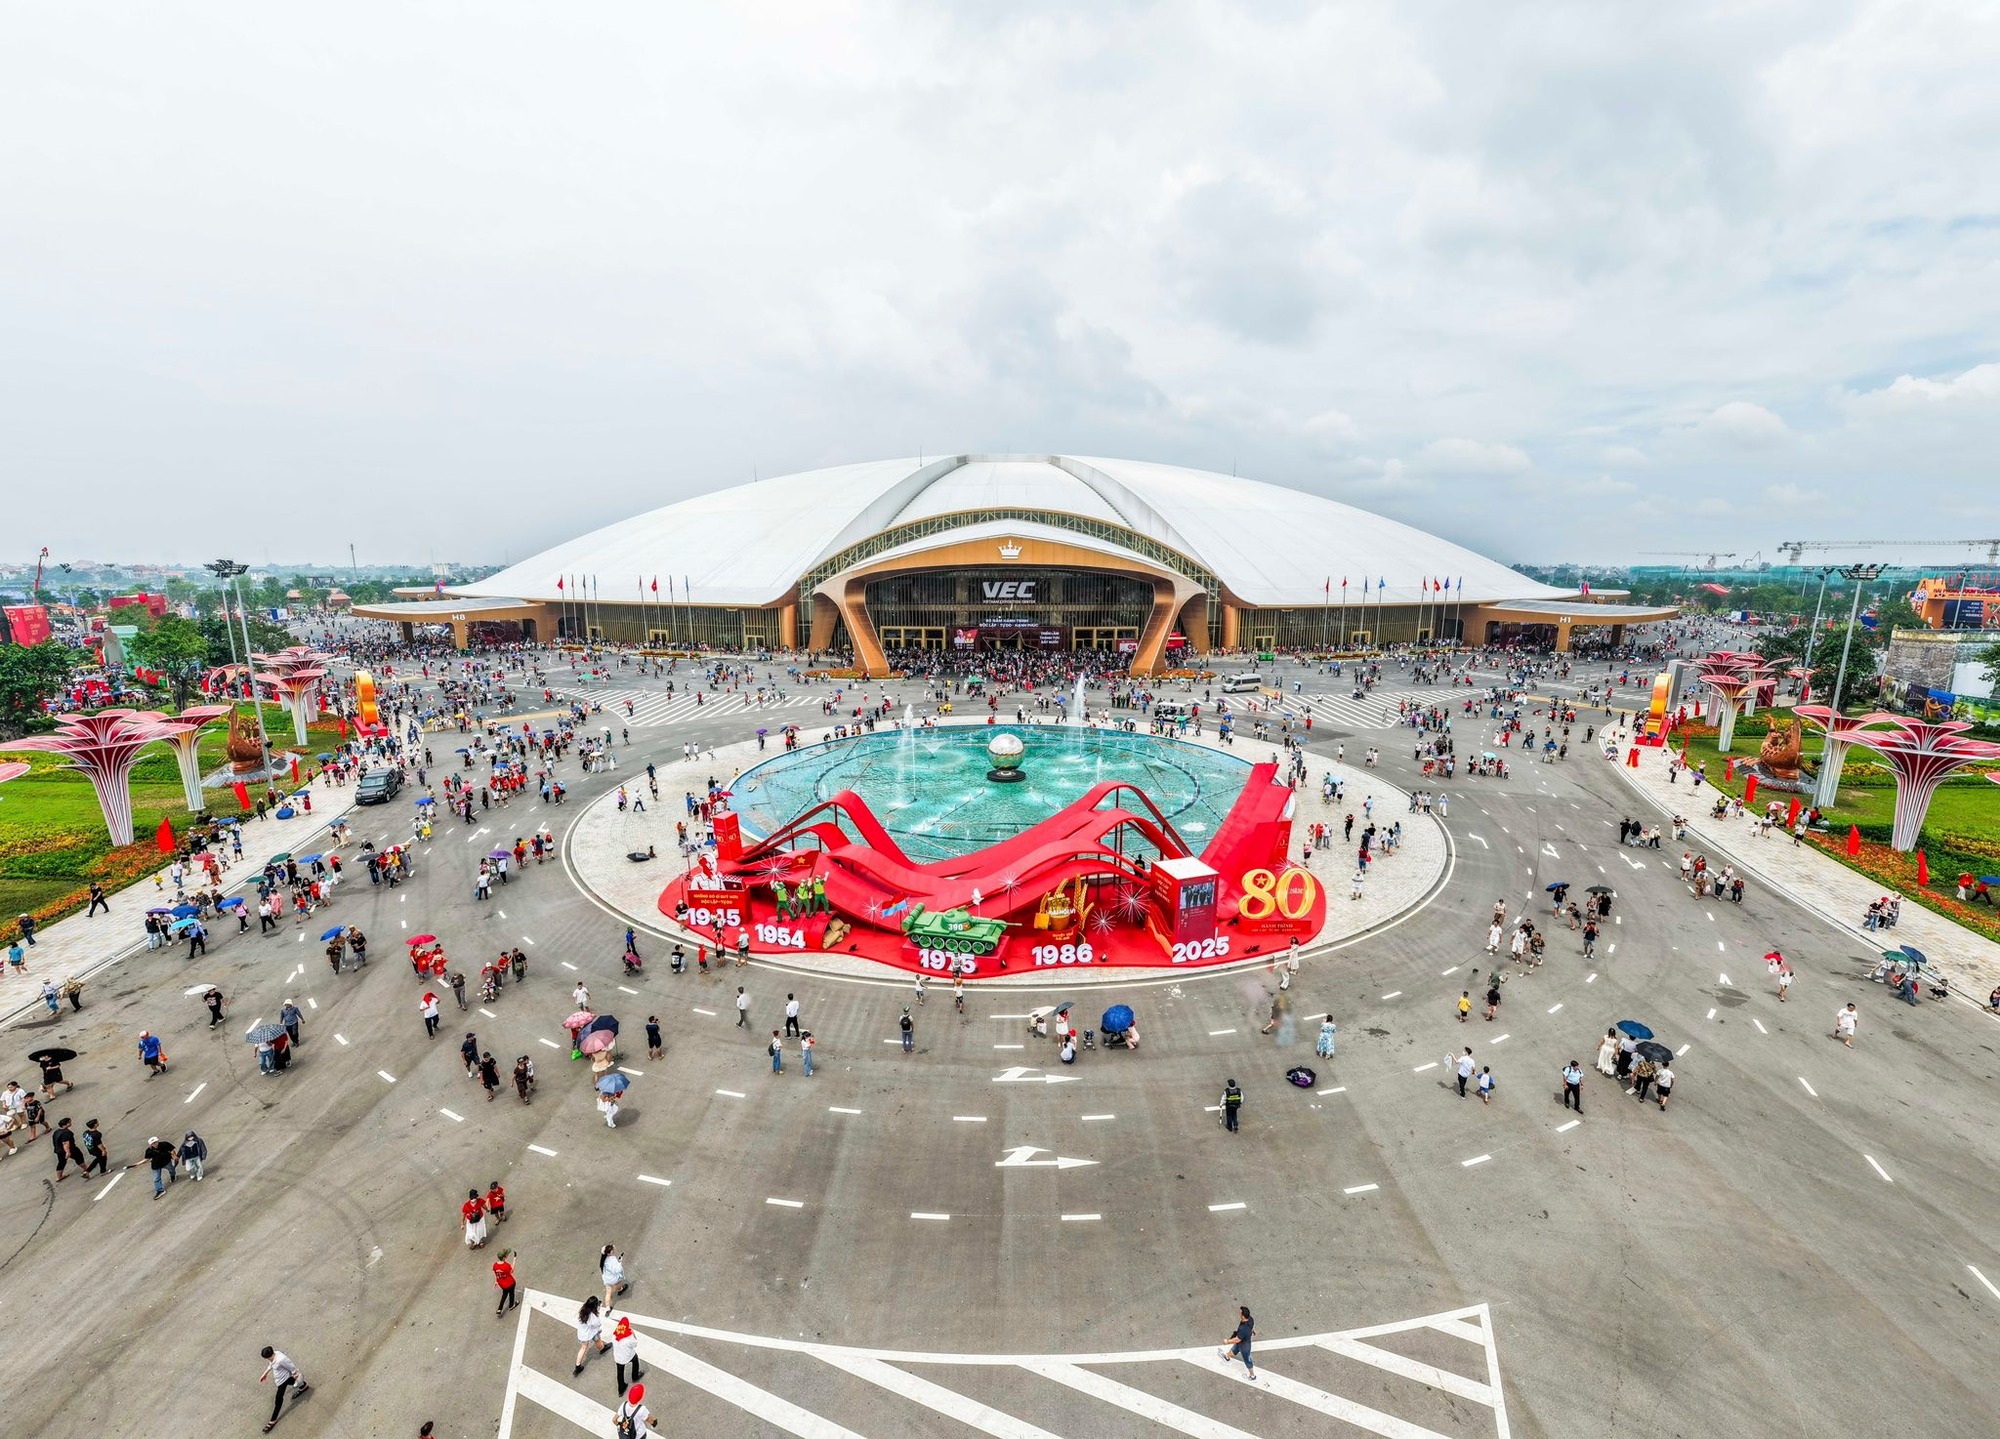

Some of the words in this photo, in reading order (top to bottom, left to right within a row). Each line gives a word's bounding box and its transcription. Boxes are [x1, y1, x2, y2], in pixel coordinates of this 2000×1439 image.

[982, 581, 1036, 598] VEC
[451, 613, 466, 621] H8
[1239, 868, 1316, 919] 80
[755, 923, 806, 949] 1954
[1032, 943, 1093, 966] 1986
[1172, 935, 1230, 963] 2025
